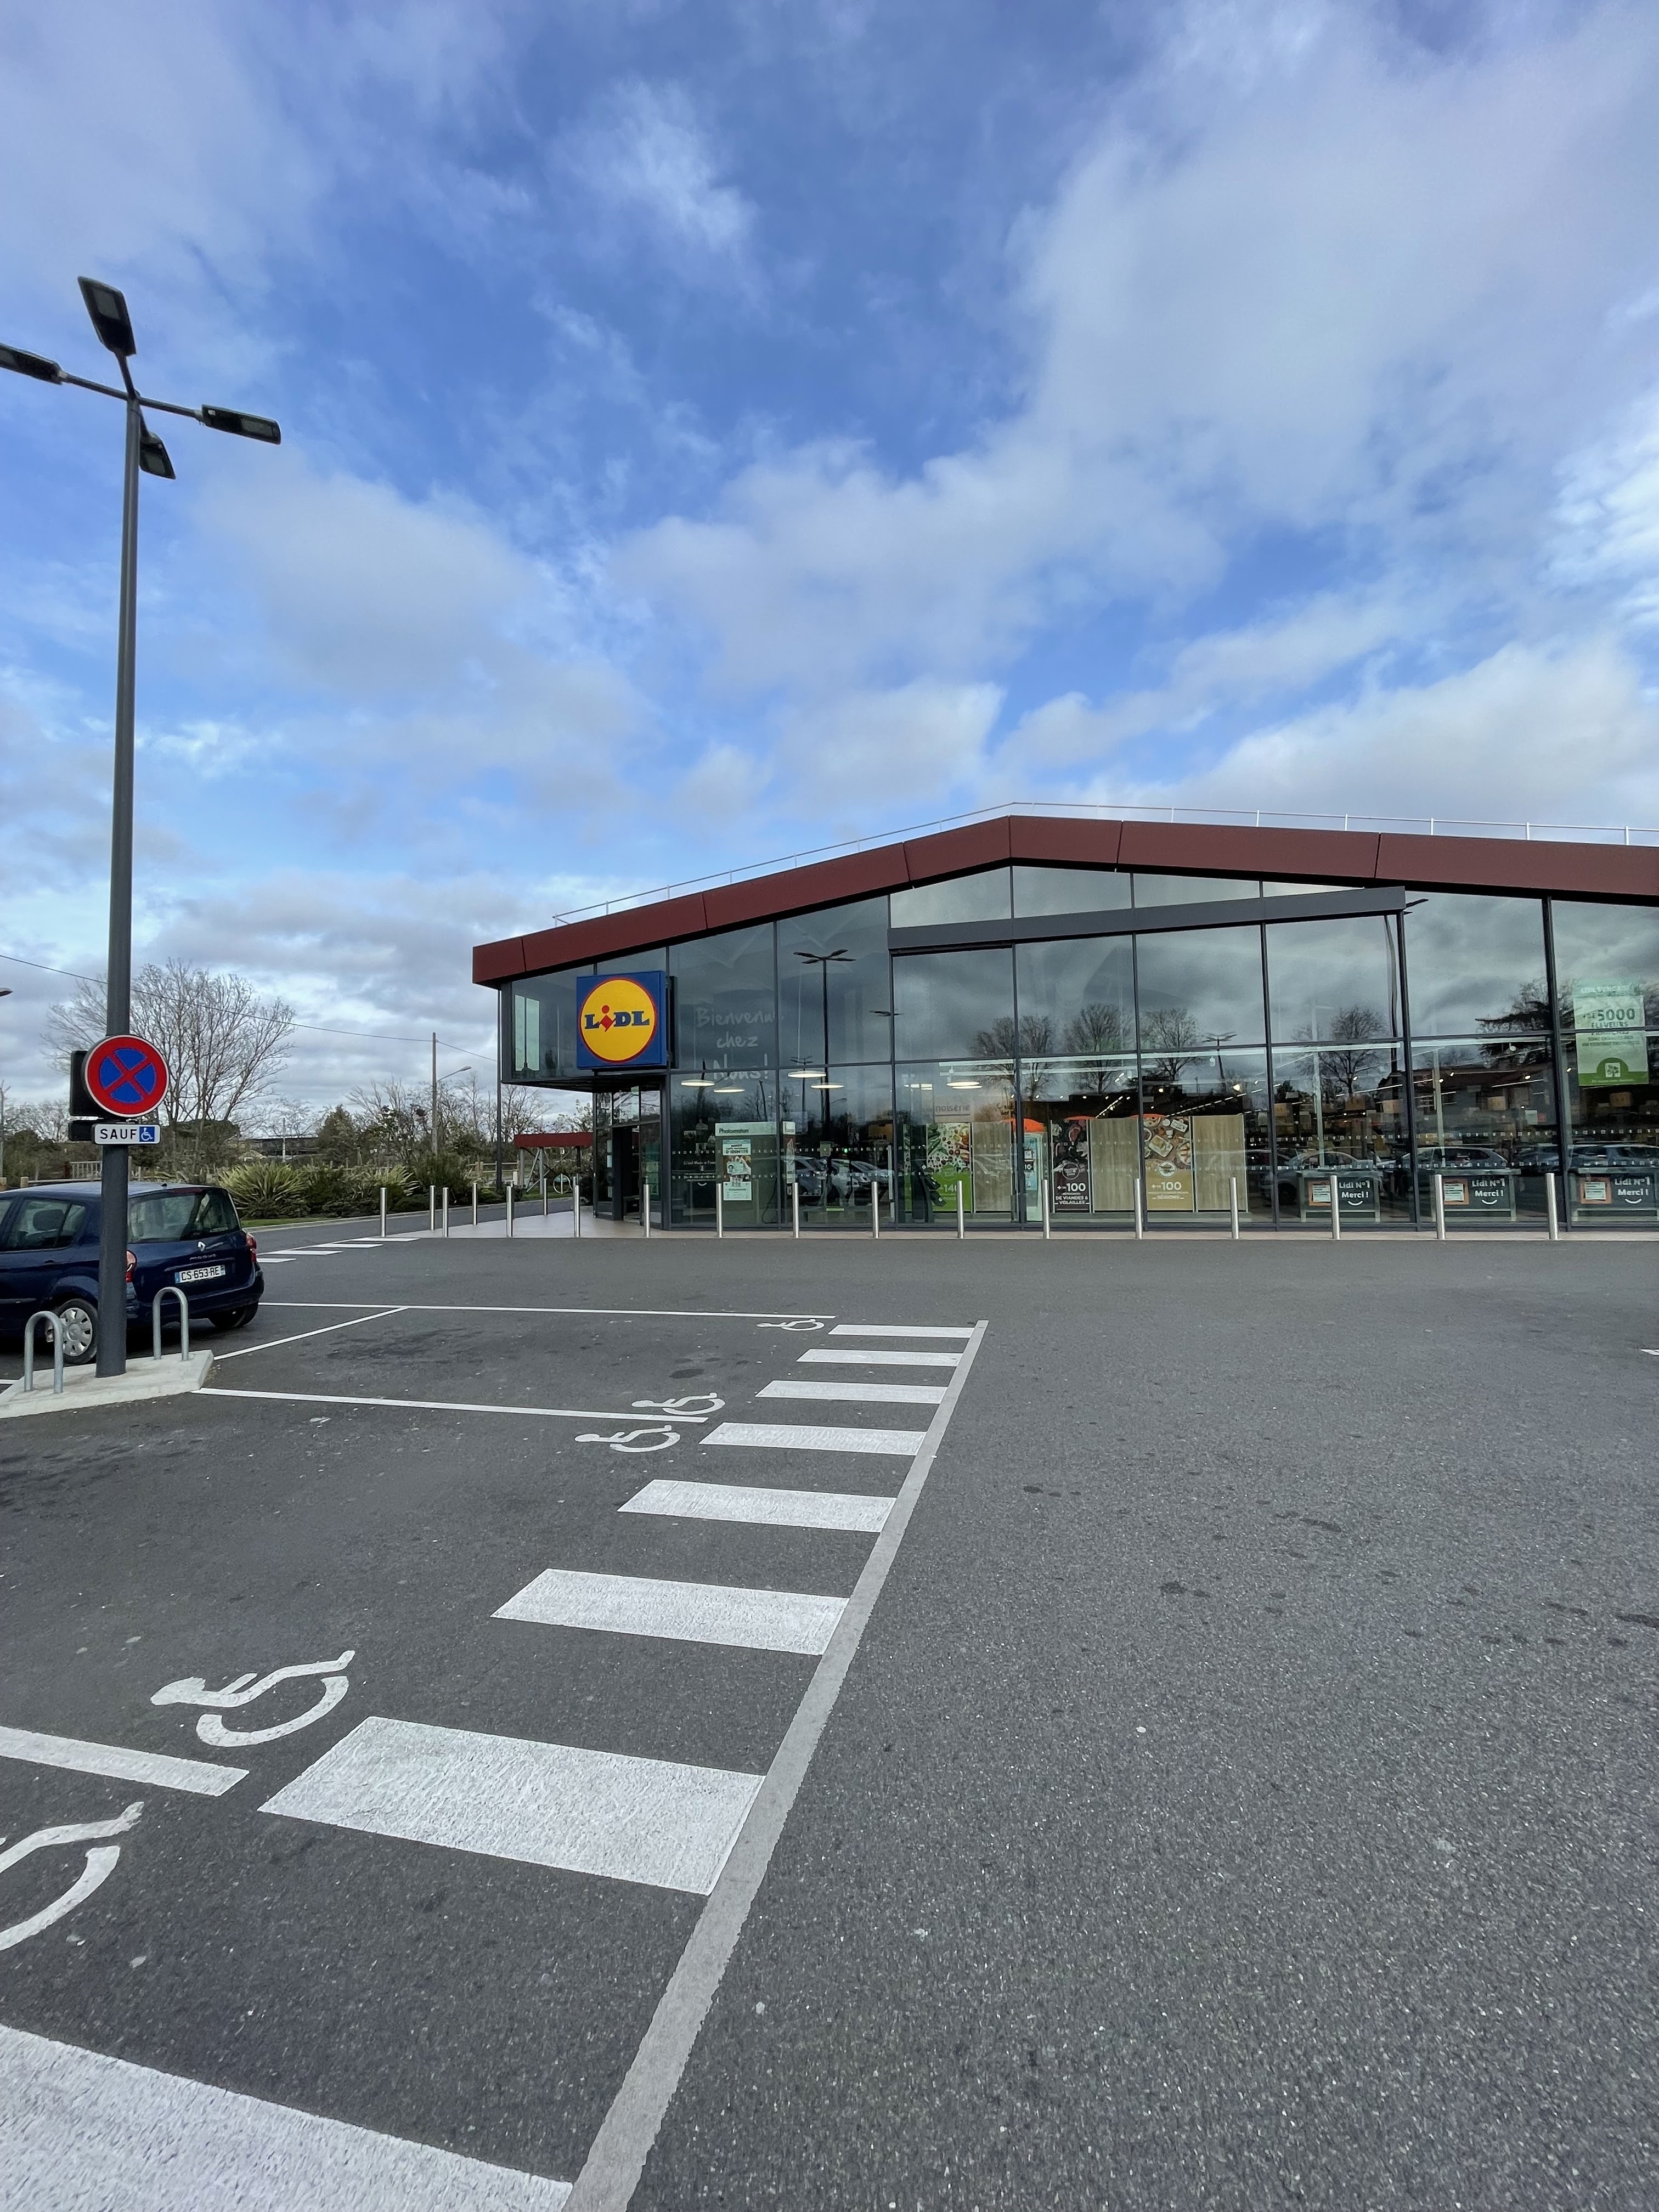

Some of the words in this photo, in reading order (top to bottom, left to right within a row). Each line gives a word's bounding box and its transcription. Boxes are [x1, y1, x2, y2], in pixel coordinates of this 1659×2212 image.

[696, 1007, 785, 1028] Bienvenu
[1598, 1008, 1635, 1021] 5000
[716, 1031, 758, 1048] chez
[100, 1128, 137, 1139] SAUF
[944, 1184, 957, 1192] 14
[1066, 1183, 1086, 1192] 100
[1161, 1181, 1182, 1190] 100
